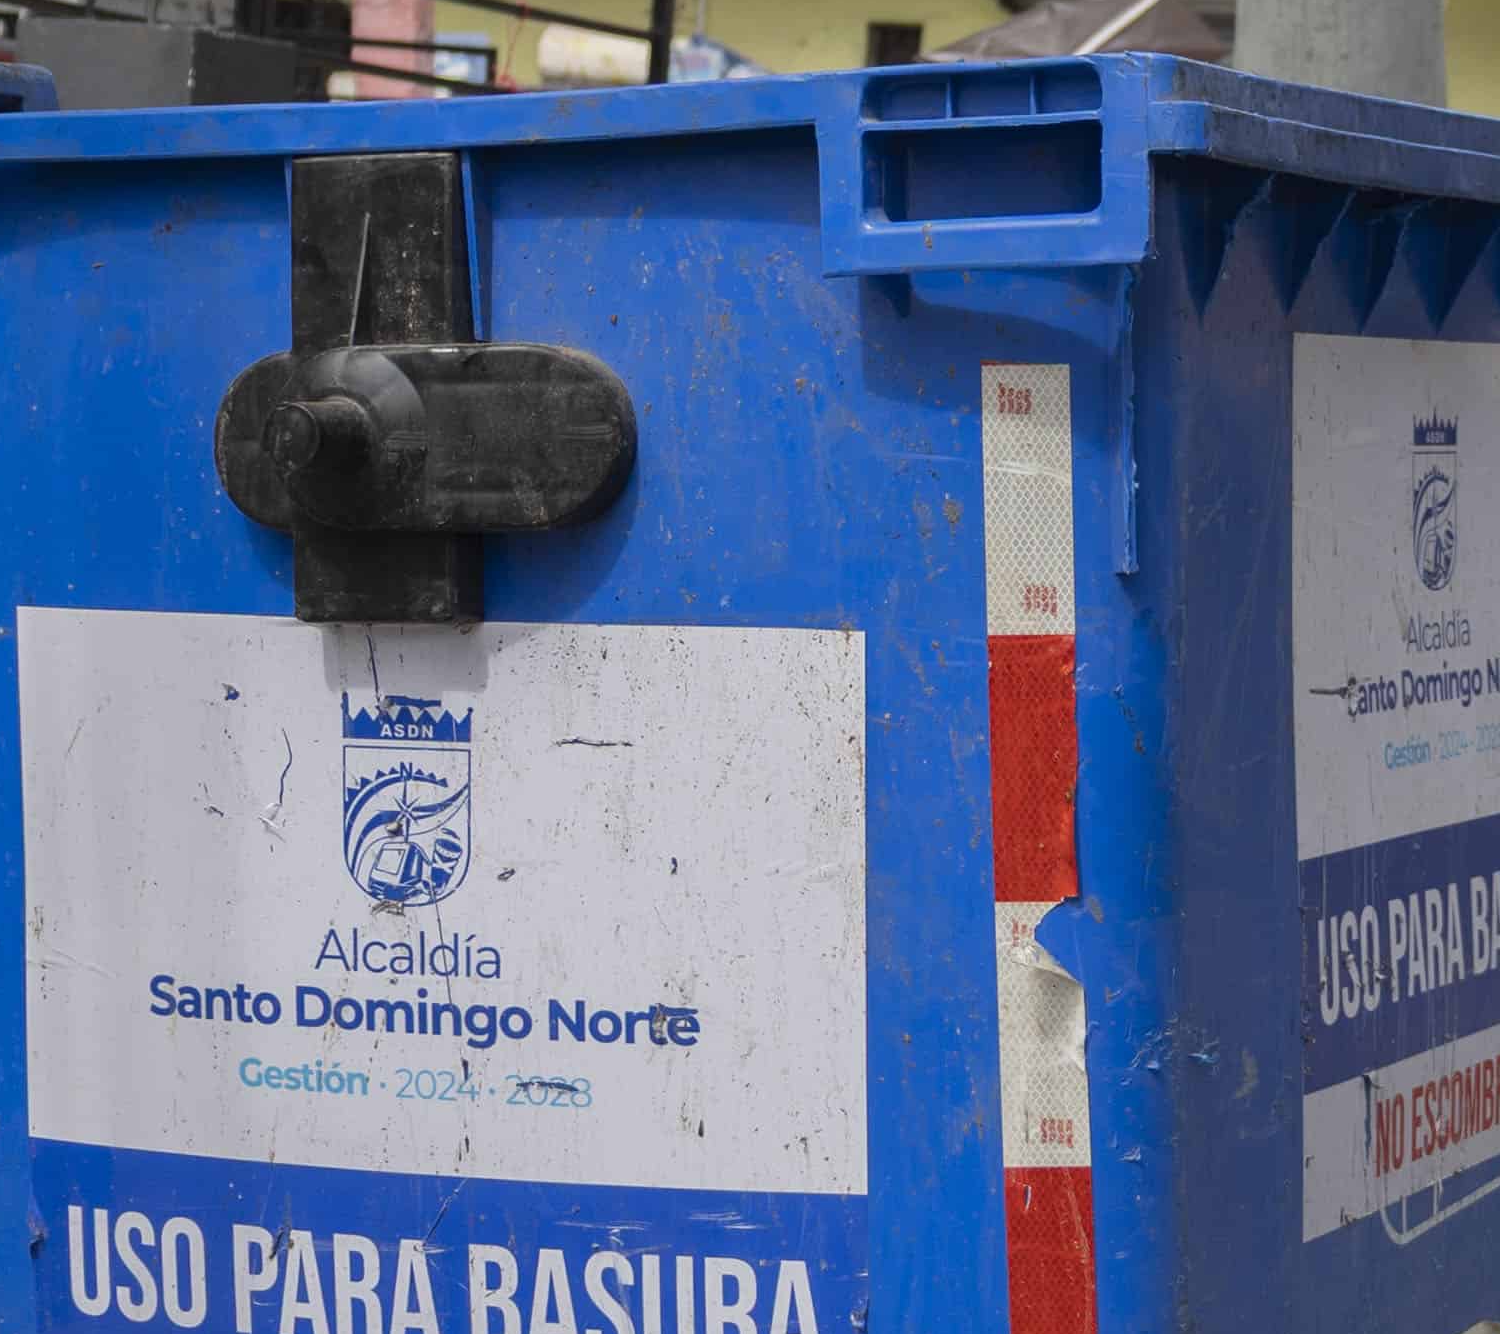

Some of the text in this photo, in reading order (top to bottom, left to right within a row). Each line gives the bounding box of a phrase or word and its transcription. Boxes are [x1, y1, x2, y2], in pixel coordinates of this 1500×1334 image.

[1406, 610, 1472, 653] Alcaldía
[1402, 661, 1483, 709] Domingo
[380, 723, 435, 739] ASDN
[314, 927, 502, 980] Alcaldía
[1318, 905, 1381, 1025] USO
[1388, 883, 1465, 1002] PARA
[149, 974, 700, 1049] Santo Domingo Norte
[238, 1056, 369, 1097] Gestión
[395, 1068, 480, 1101] 2024
[1375, 1093, 1405, 1178] NO
[68, 1204, 208, 1330] USO
